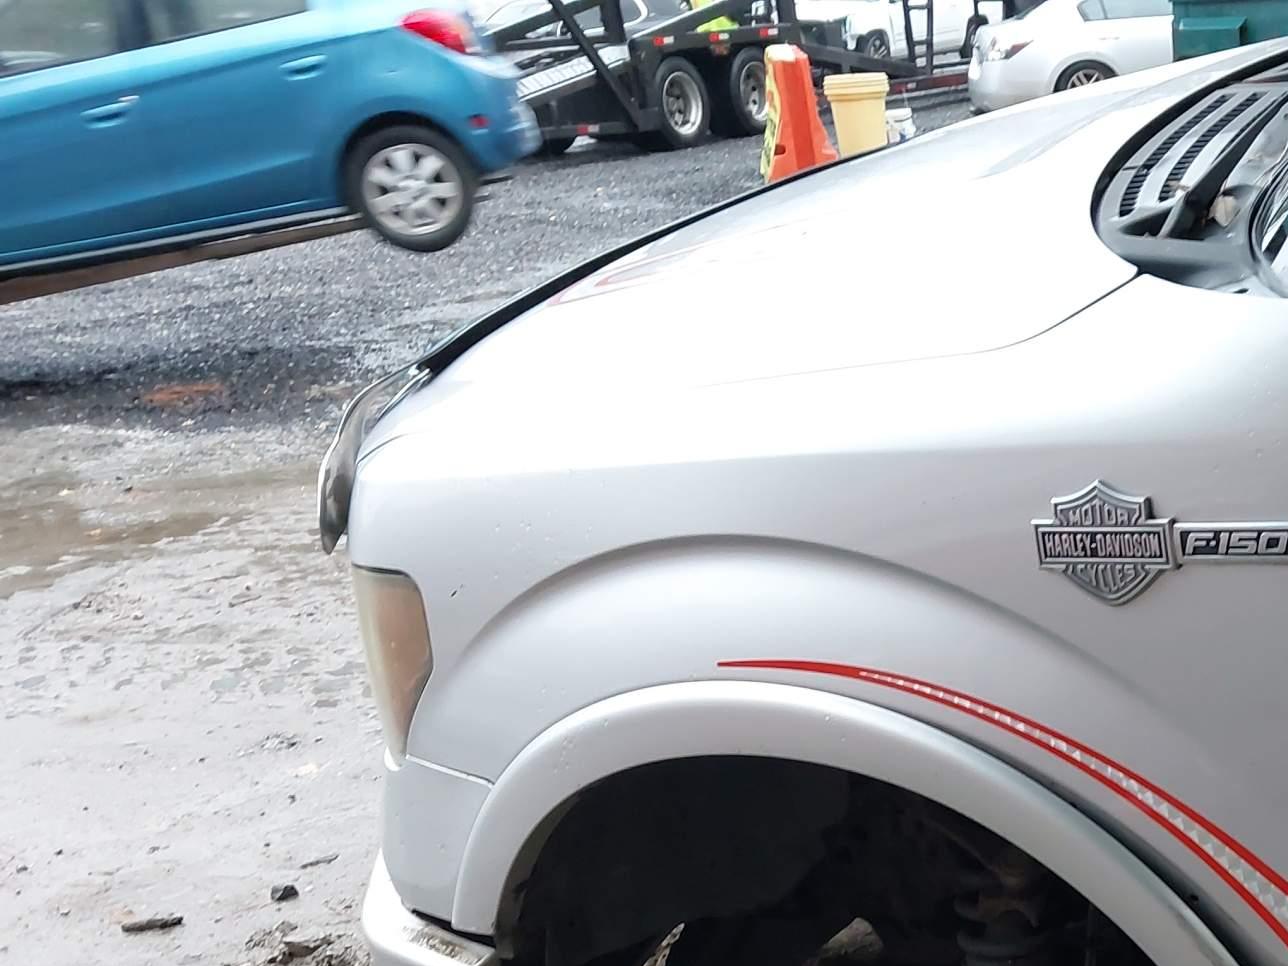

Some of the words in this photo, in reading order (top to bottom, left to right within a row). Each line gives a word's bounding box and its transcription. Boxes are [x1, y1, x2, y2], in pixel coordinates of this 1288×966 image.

[1067, 499, 1130, 526] MOTOR
[1043, 532, 1161, 558] HARLEY-DAVIDSON
[1075, 563, 1136, 592] CYCLES
